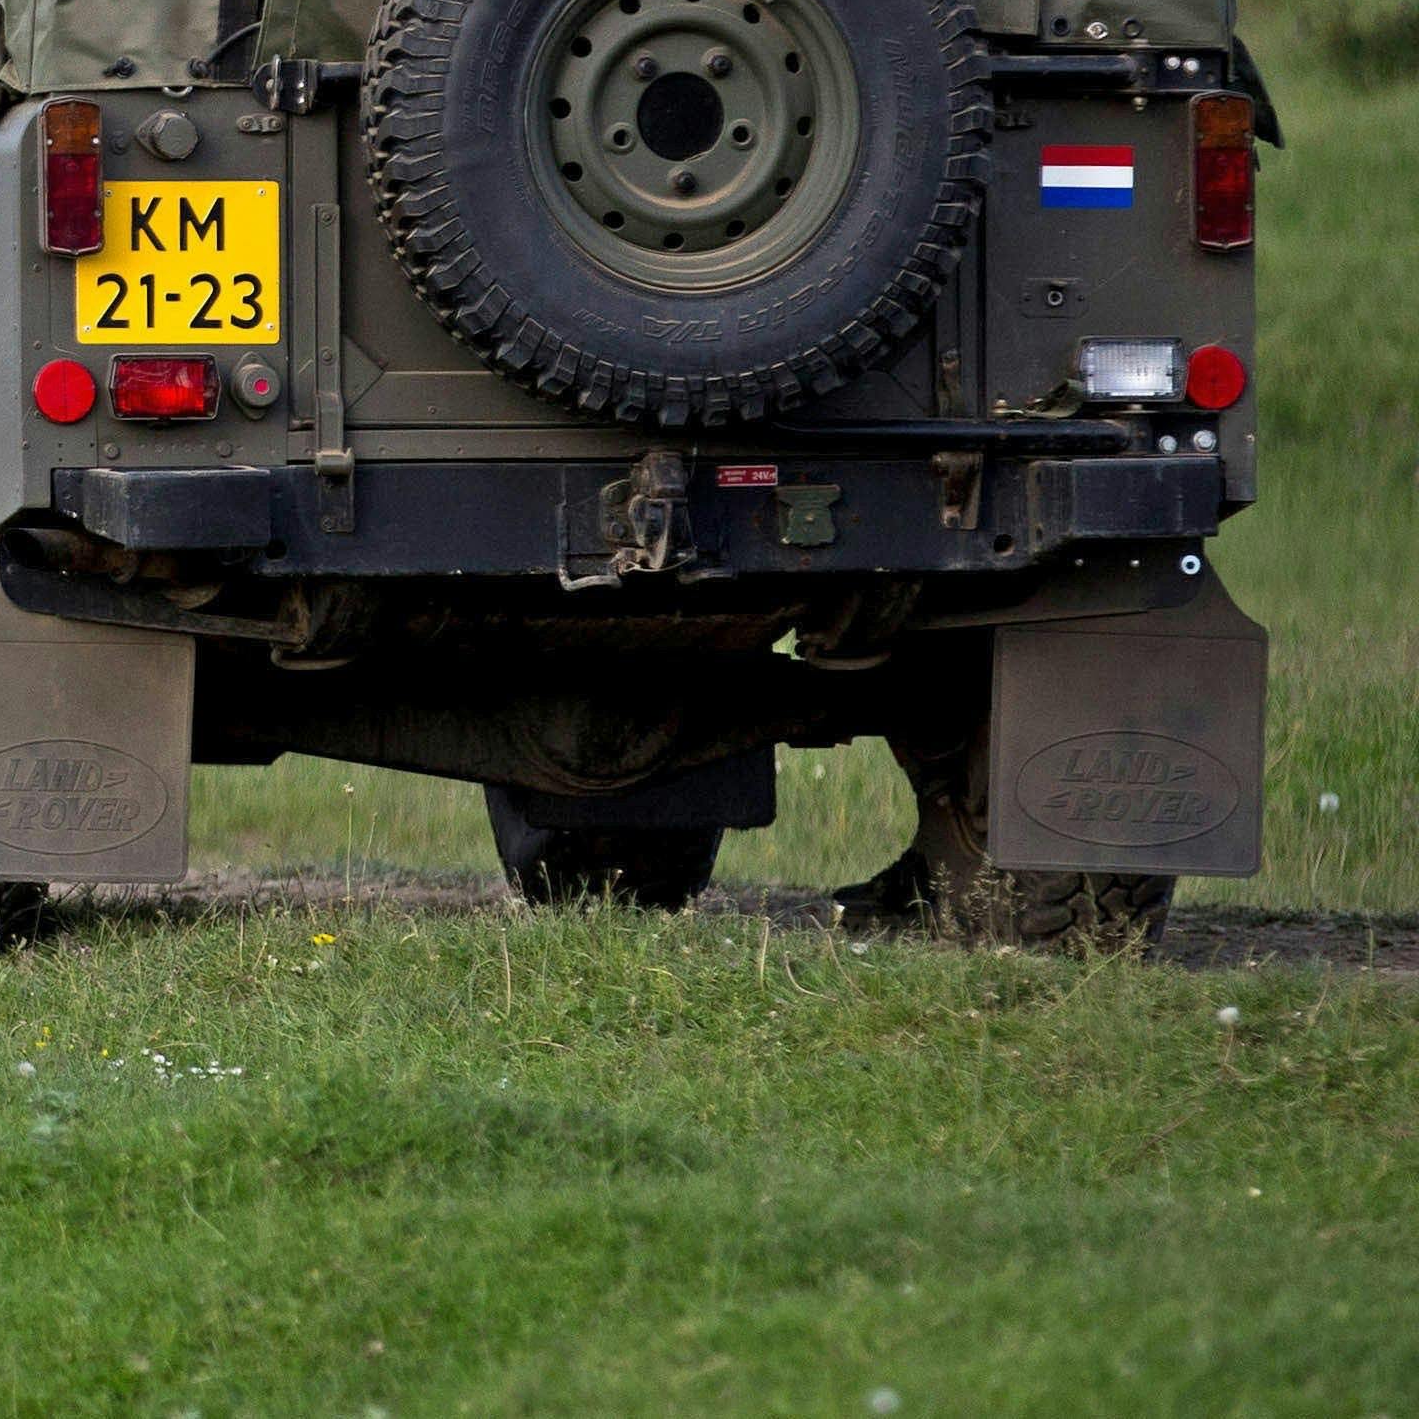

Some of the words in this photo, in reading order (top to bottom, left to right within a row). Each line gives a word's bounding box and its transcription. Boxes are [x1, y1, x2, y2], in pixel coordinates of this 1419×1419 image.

[130, 197, 225, 251] KM
[97, 273, 263, 329] 21-23
[0, 758, 104, 792] LAND
[1060, 749, 1171, 784] LAND
[10, 797, 142, 832] ROVER
[1067, 789, 1210, 825] ROVER
